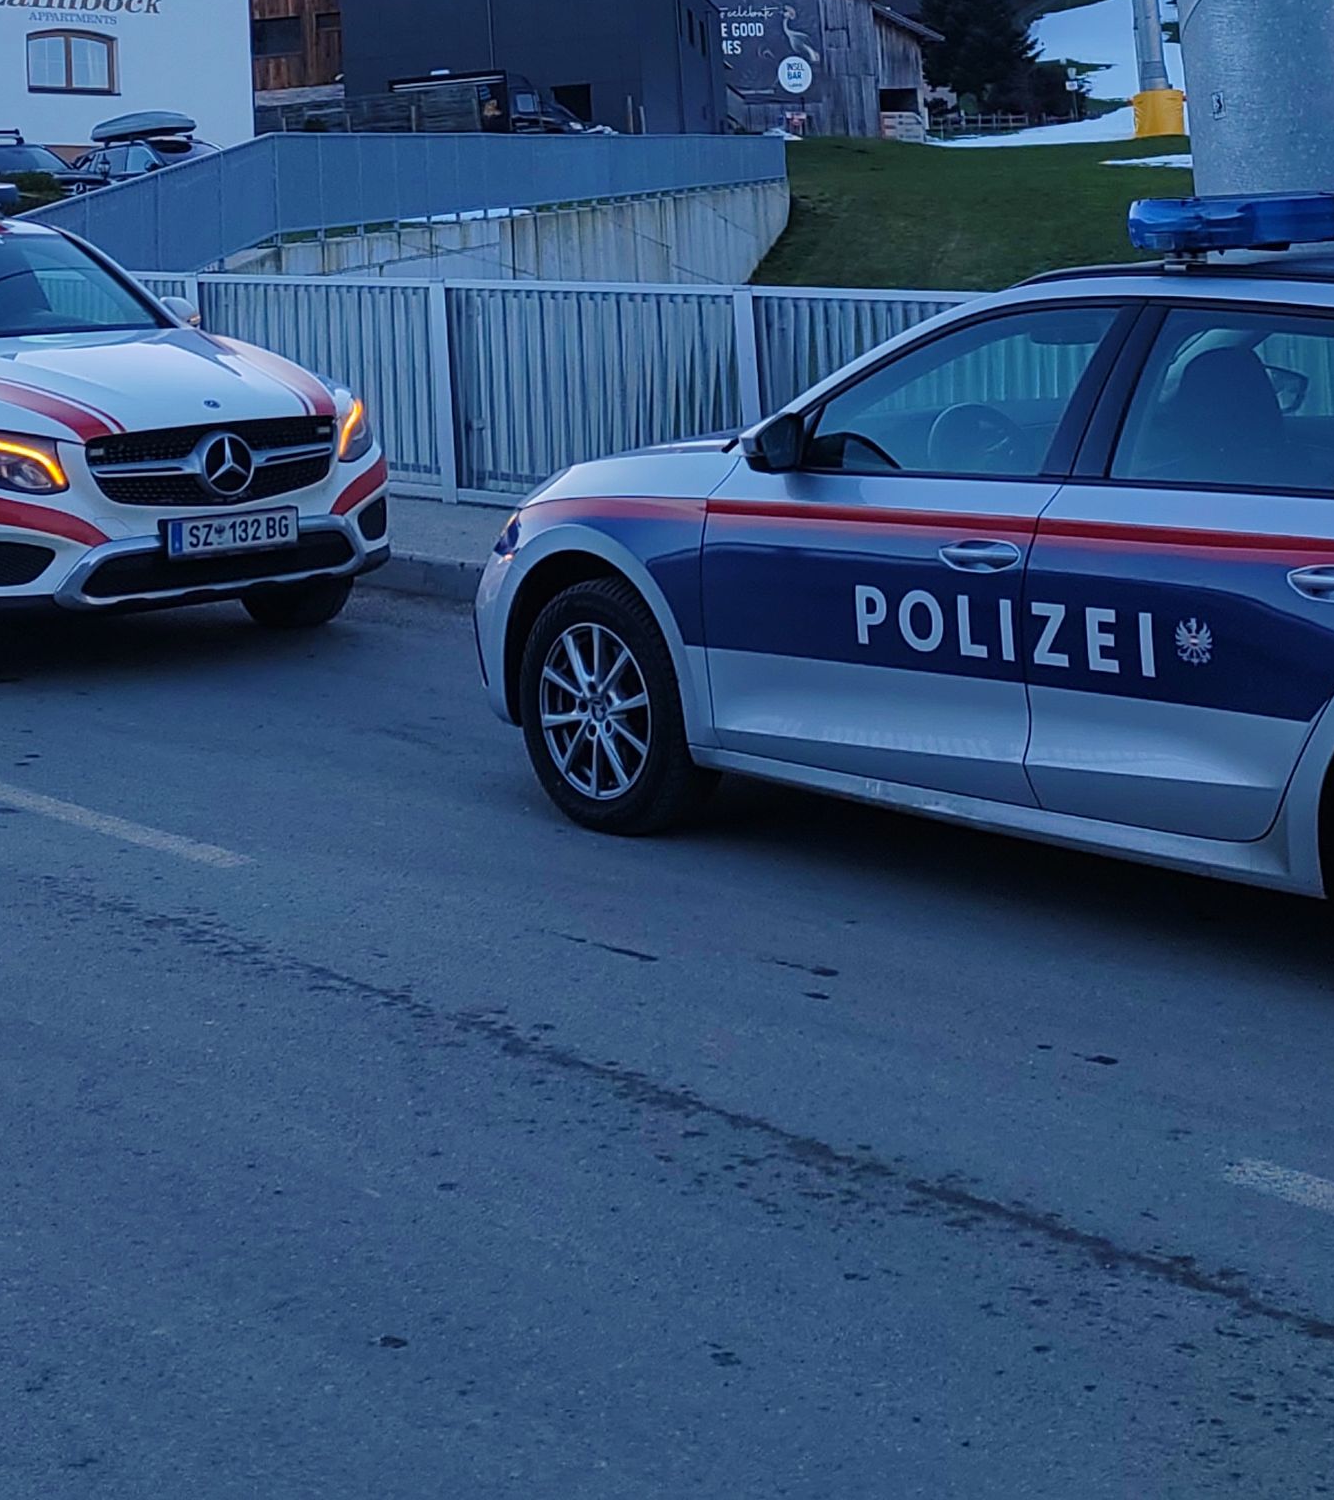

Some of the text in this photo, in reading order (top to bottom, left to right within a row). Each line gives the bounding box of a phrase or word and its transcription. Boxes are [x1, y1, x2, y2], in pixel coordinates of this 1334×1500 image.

[28, 11, 118, 26] APPARTMENTS
[731, 22, 764, 37] GOOD
[787, 71, 802, 80] BAR
[189, 515, 289, 548] SZ 132 BG
[855, 584, 1157, 678] POLIZEI
